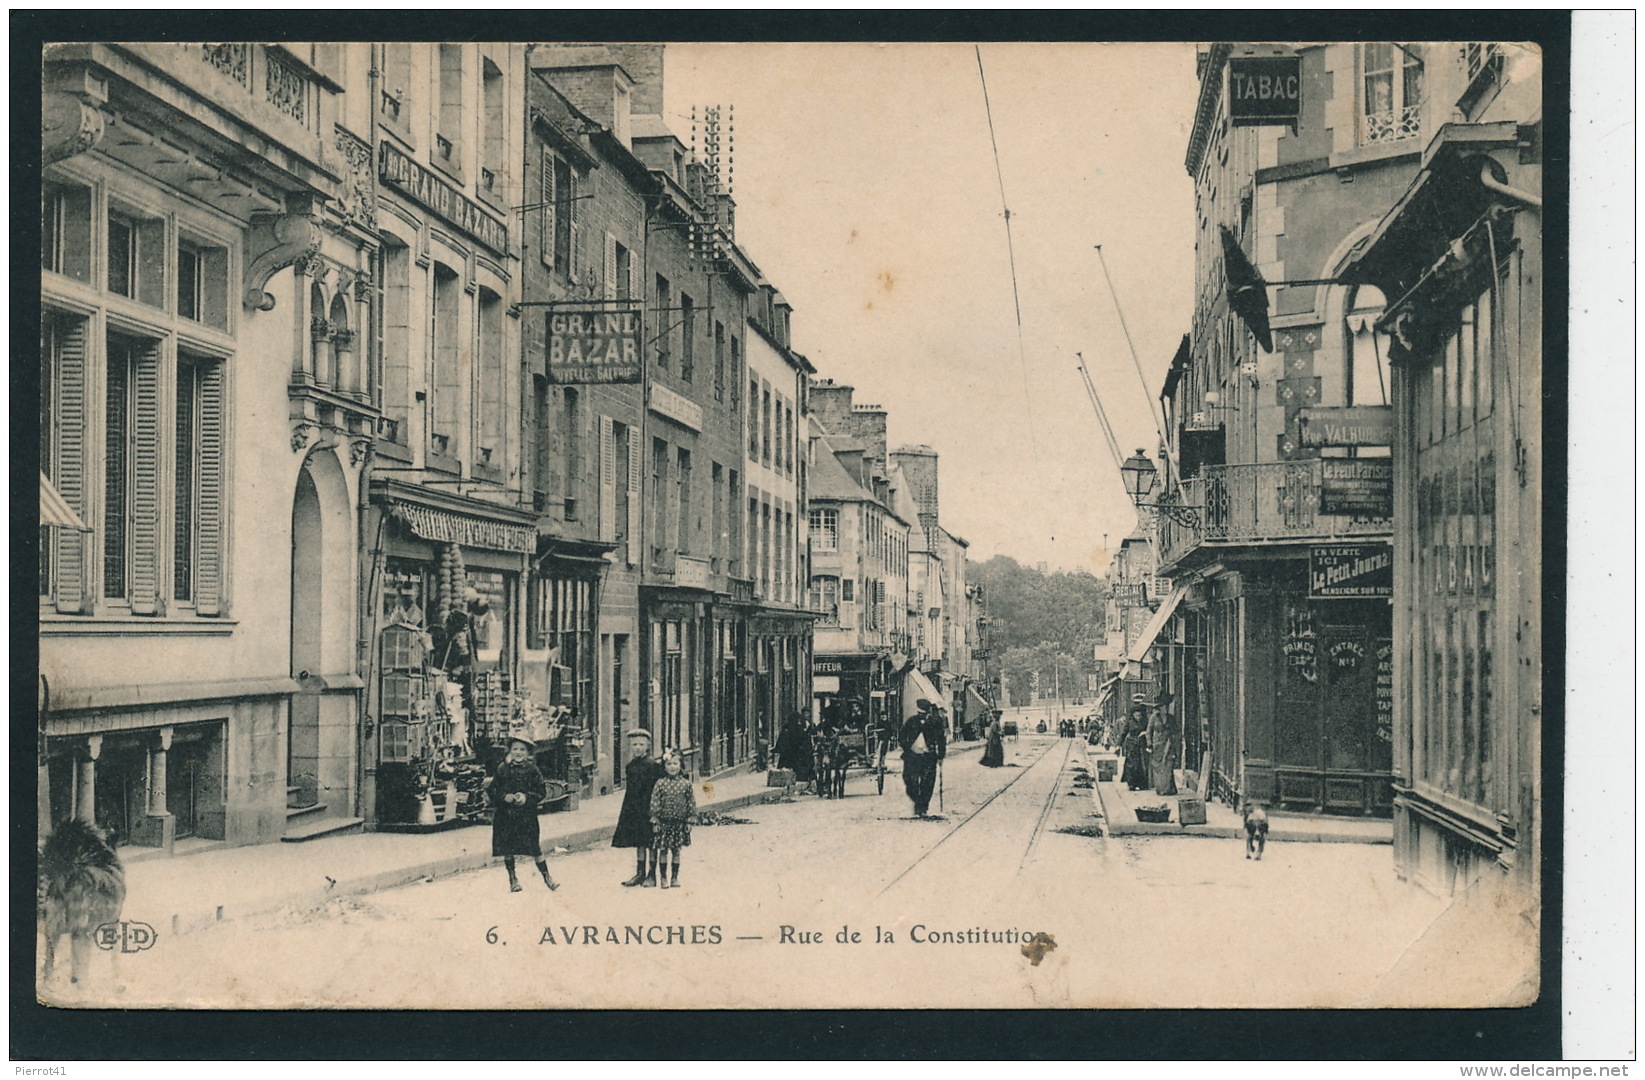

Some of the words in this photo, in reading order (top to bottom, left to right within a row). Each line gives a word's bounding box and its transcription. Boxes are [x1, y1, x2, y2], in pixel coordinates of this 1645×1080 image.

[1233, 73, 1297, 99] TABAC
[400, 155, 449, 217] GRAND
[455, 195, 500, 251] BAZAR
[551, 312, 640, 335] GRAND
[550, 336, 639, 363] BAZAR
[1314, 548, 1327, 556] EN
[1330, 548, 1360, 556] VENTE
[1319, 557, 1337, 565] ICI
[1313, 571, 1325, 590] Le
[1326, 562, 1350, 586] Petit
